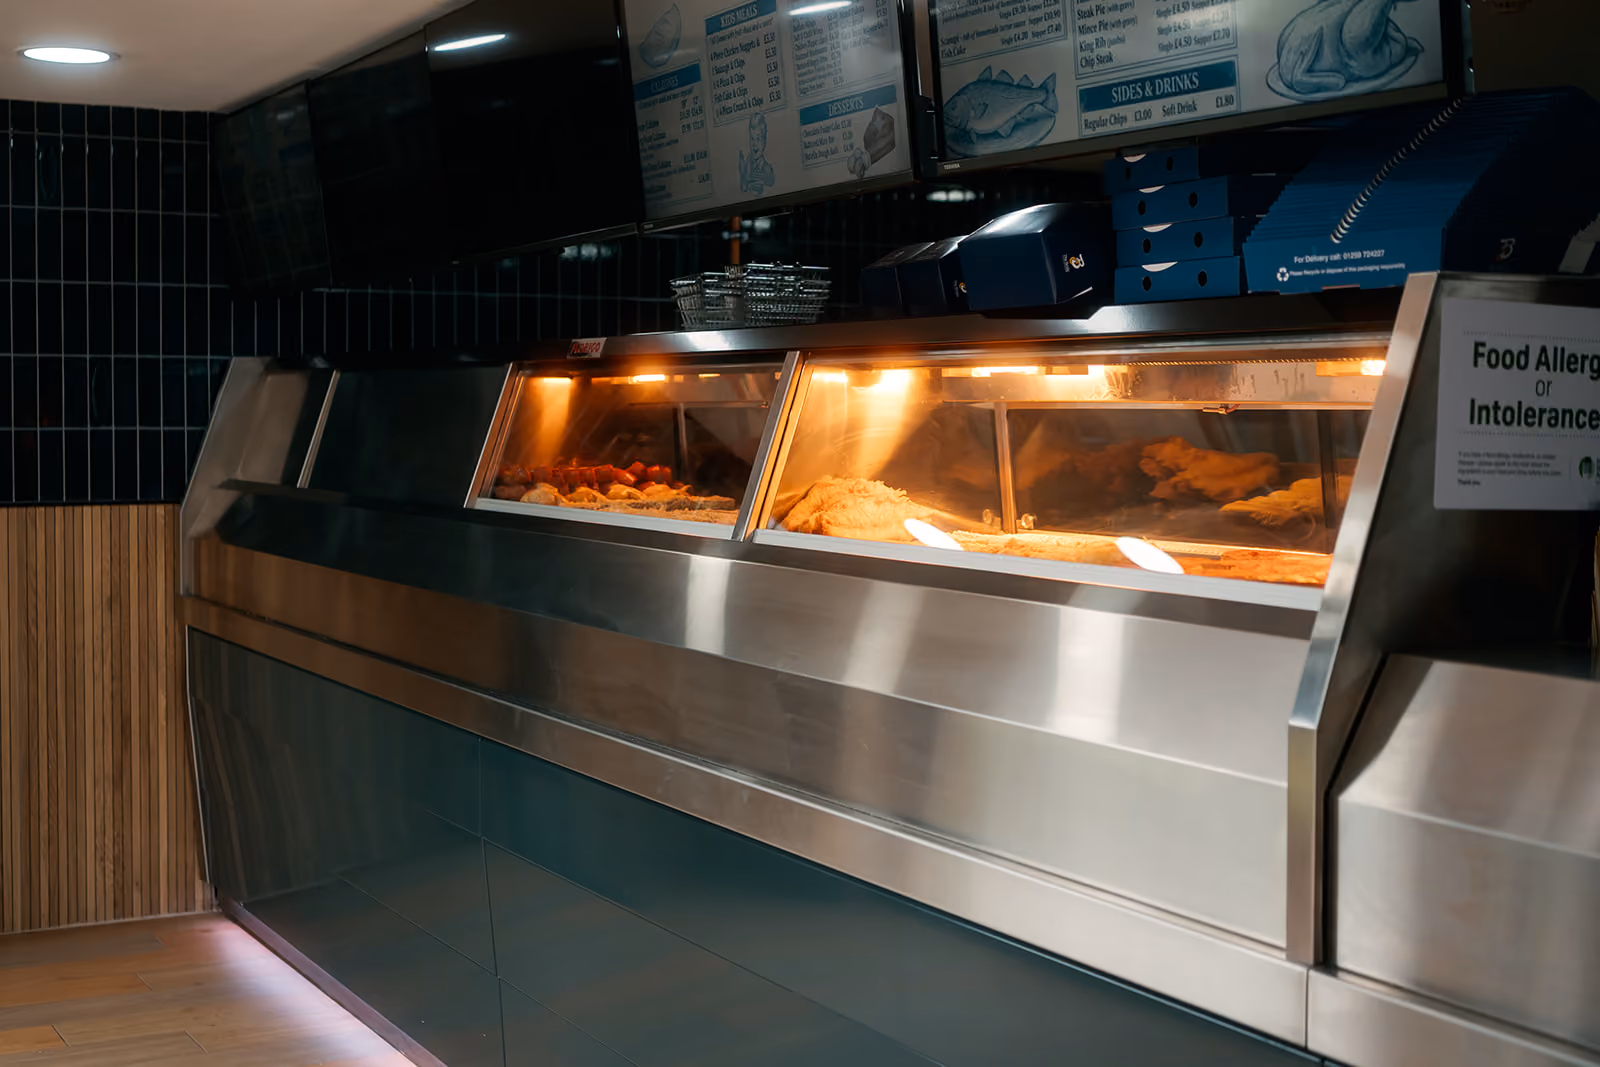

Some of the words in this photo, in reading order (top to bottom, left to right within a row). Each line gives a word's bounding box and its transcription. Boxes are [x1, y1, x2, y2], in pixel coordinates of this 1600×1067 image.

[1077, 5, 1095, 20] Steak
[1095, 4, 1106, 16] Pie
[1078, 22, 1098, 36] Mince
[1098, 19, 1109, 32] Pie
[1080, 54, 1096, 70] Chip
[1095, 51, 1114, 65] Steak
[1111, 84, 1143, 104] SIDES
[1144, 81, 1154, 98] &
[1155, 72, 1200, 95] DRINKS
[828, 97, 864, 117] DESSERTS
[1083, 115, 1109, 132] Regular
[1108, 112, 1128, 128] Chips
[1161, 104, 1176, 118] Soft
[1176, 101, 1198, 115] Drink
[1215, 94, 1235, 108] £1.80
[1294, 255, 1305, 264] For
[1305, 254, 1329, 264] Delivery
[1472, 340, 1531, 372] Food
[1534, 343, 1600, 382] Allerg
[1535, 380, 1553, 398] or
[1469, 397, 1600, 431] Intolerance
